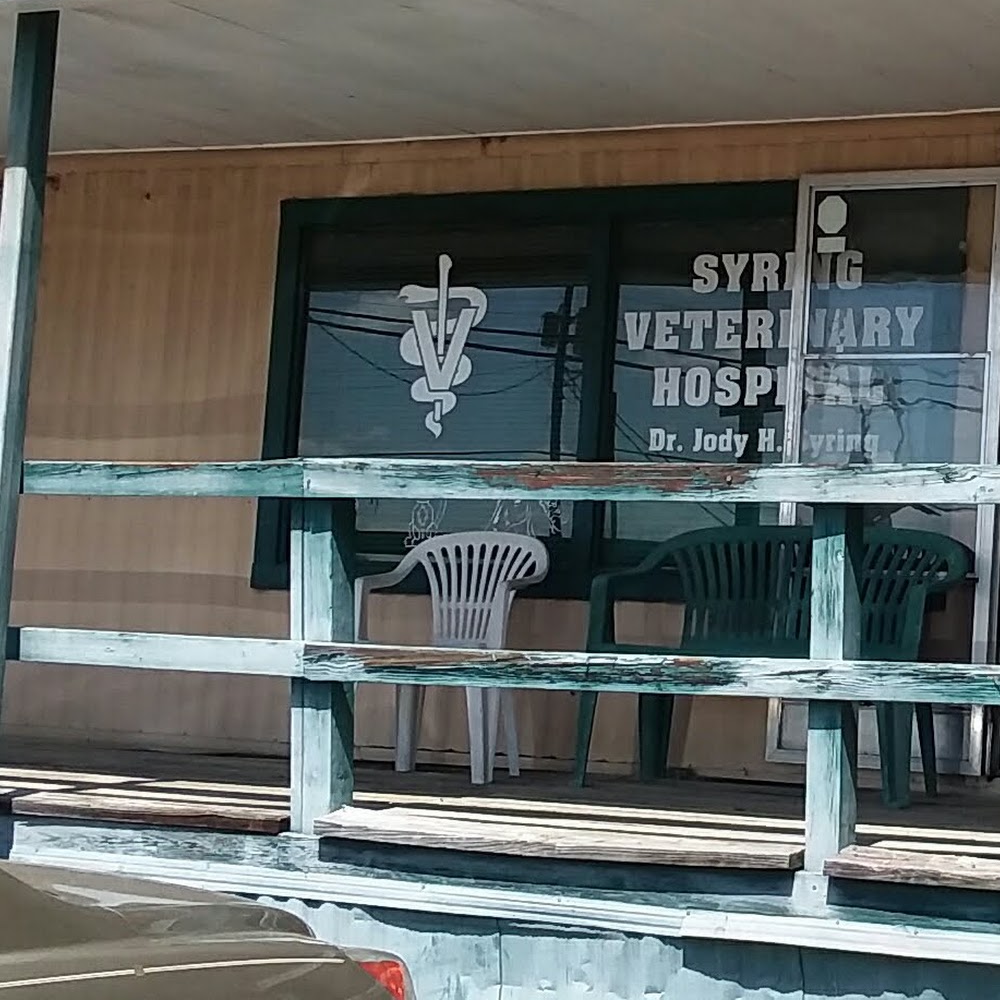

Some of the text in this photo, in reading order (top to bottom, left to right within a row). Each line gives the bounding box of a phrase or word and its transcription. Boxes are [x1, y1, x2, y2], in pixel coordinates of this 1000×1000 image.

[648, 427, 880, 464] Dr. Jody H. yring
